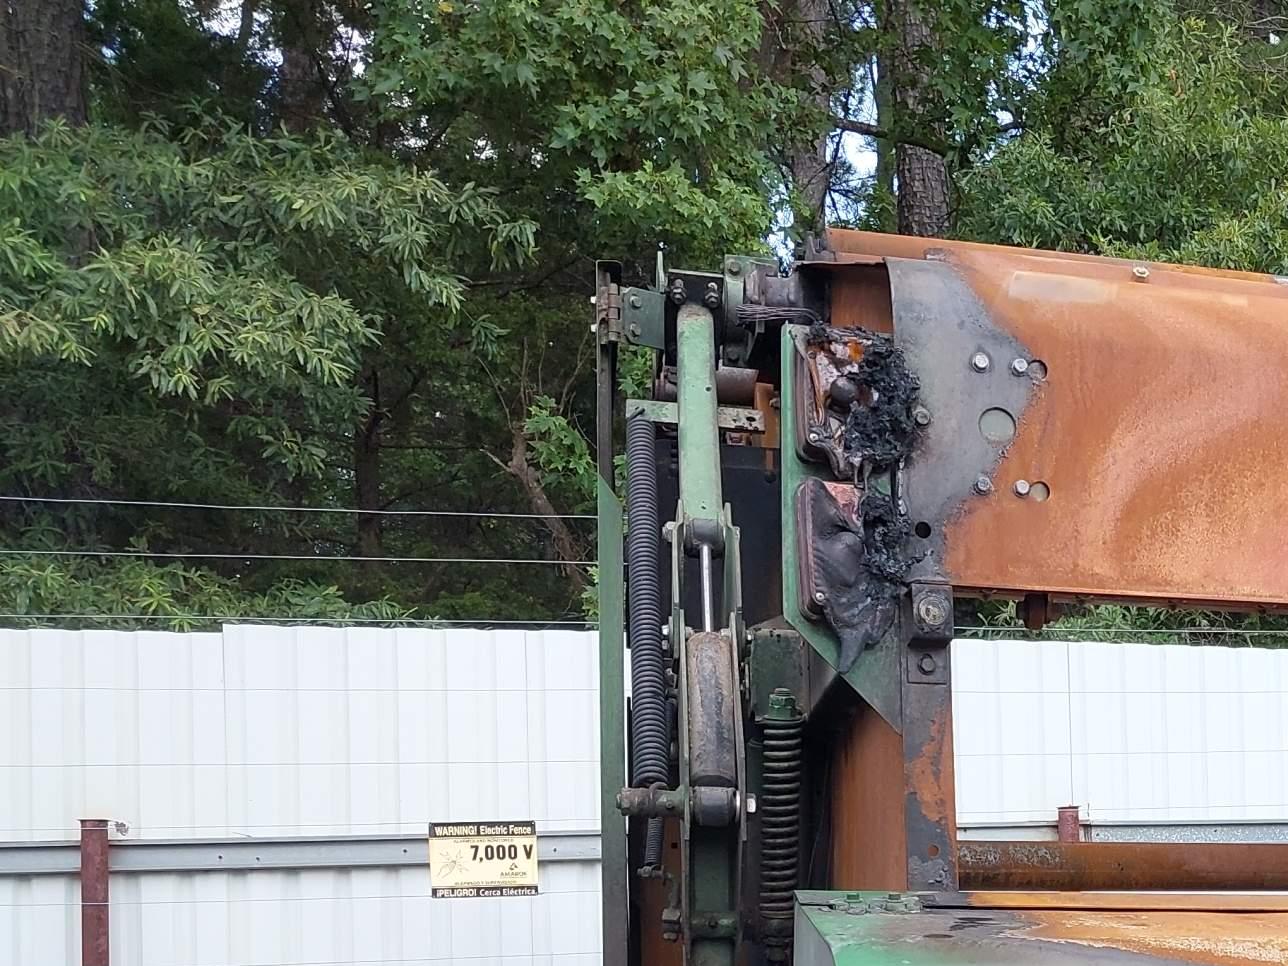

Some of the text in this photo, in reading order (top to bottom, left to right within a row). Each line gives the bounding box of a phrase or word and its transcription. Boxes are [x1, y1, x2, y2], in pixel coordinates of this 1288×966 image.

[434, 824, 531, 836] WARNING! Electric Fence
[470, 844, 533, 863] 7,000 V
[479, 888, 501, 897] Cerca
